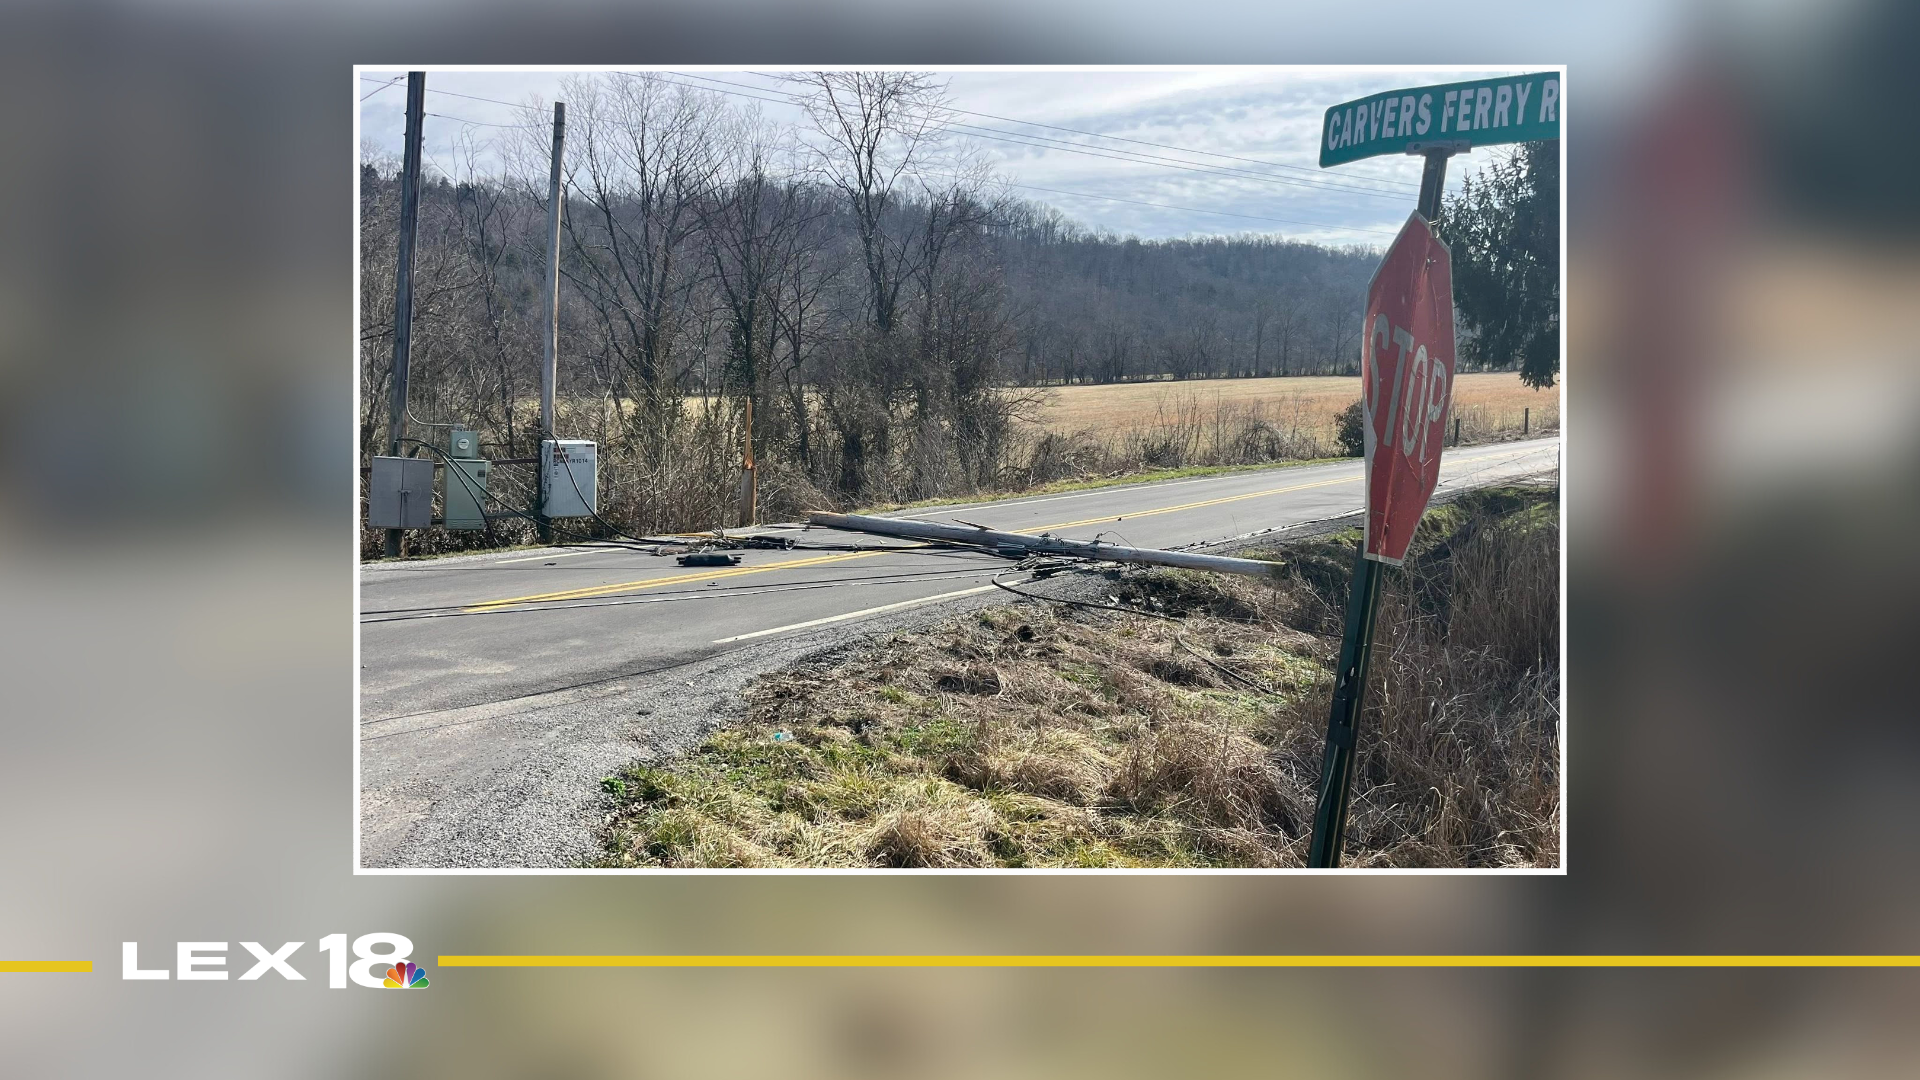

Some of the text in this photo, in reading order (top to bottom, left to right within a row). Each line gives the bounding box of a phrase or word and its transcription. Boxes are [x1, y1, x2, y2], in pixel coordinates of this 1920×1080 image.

[1327, 93, 1433, 151] CARVERS
[1440, 82, 1533, 133] FERRY
[1367, 312, 1447, 464] STOP
